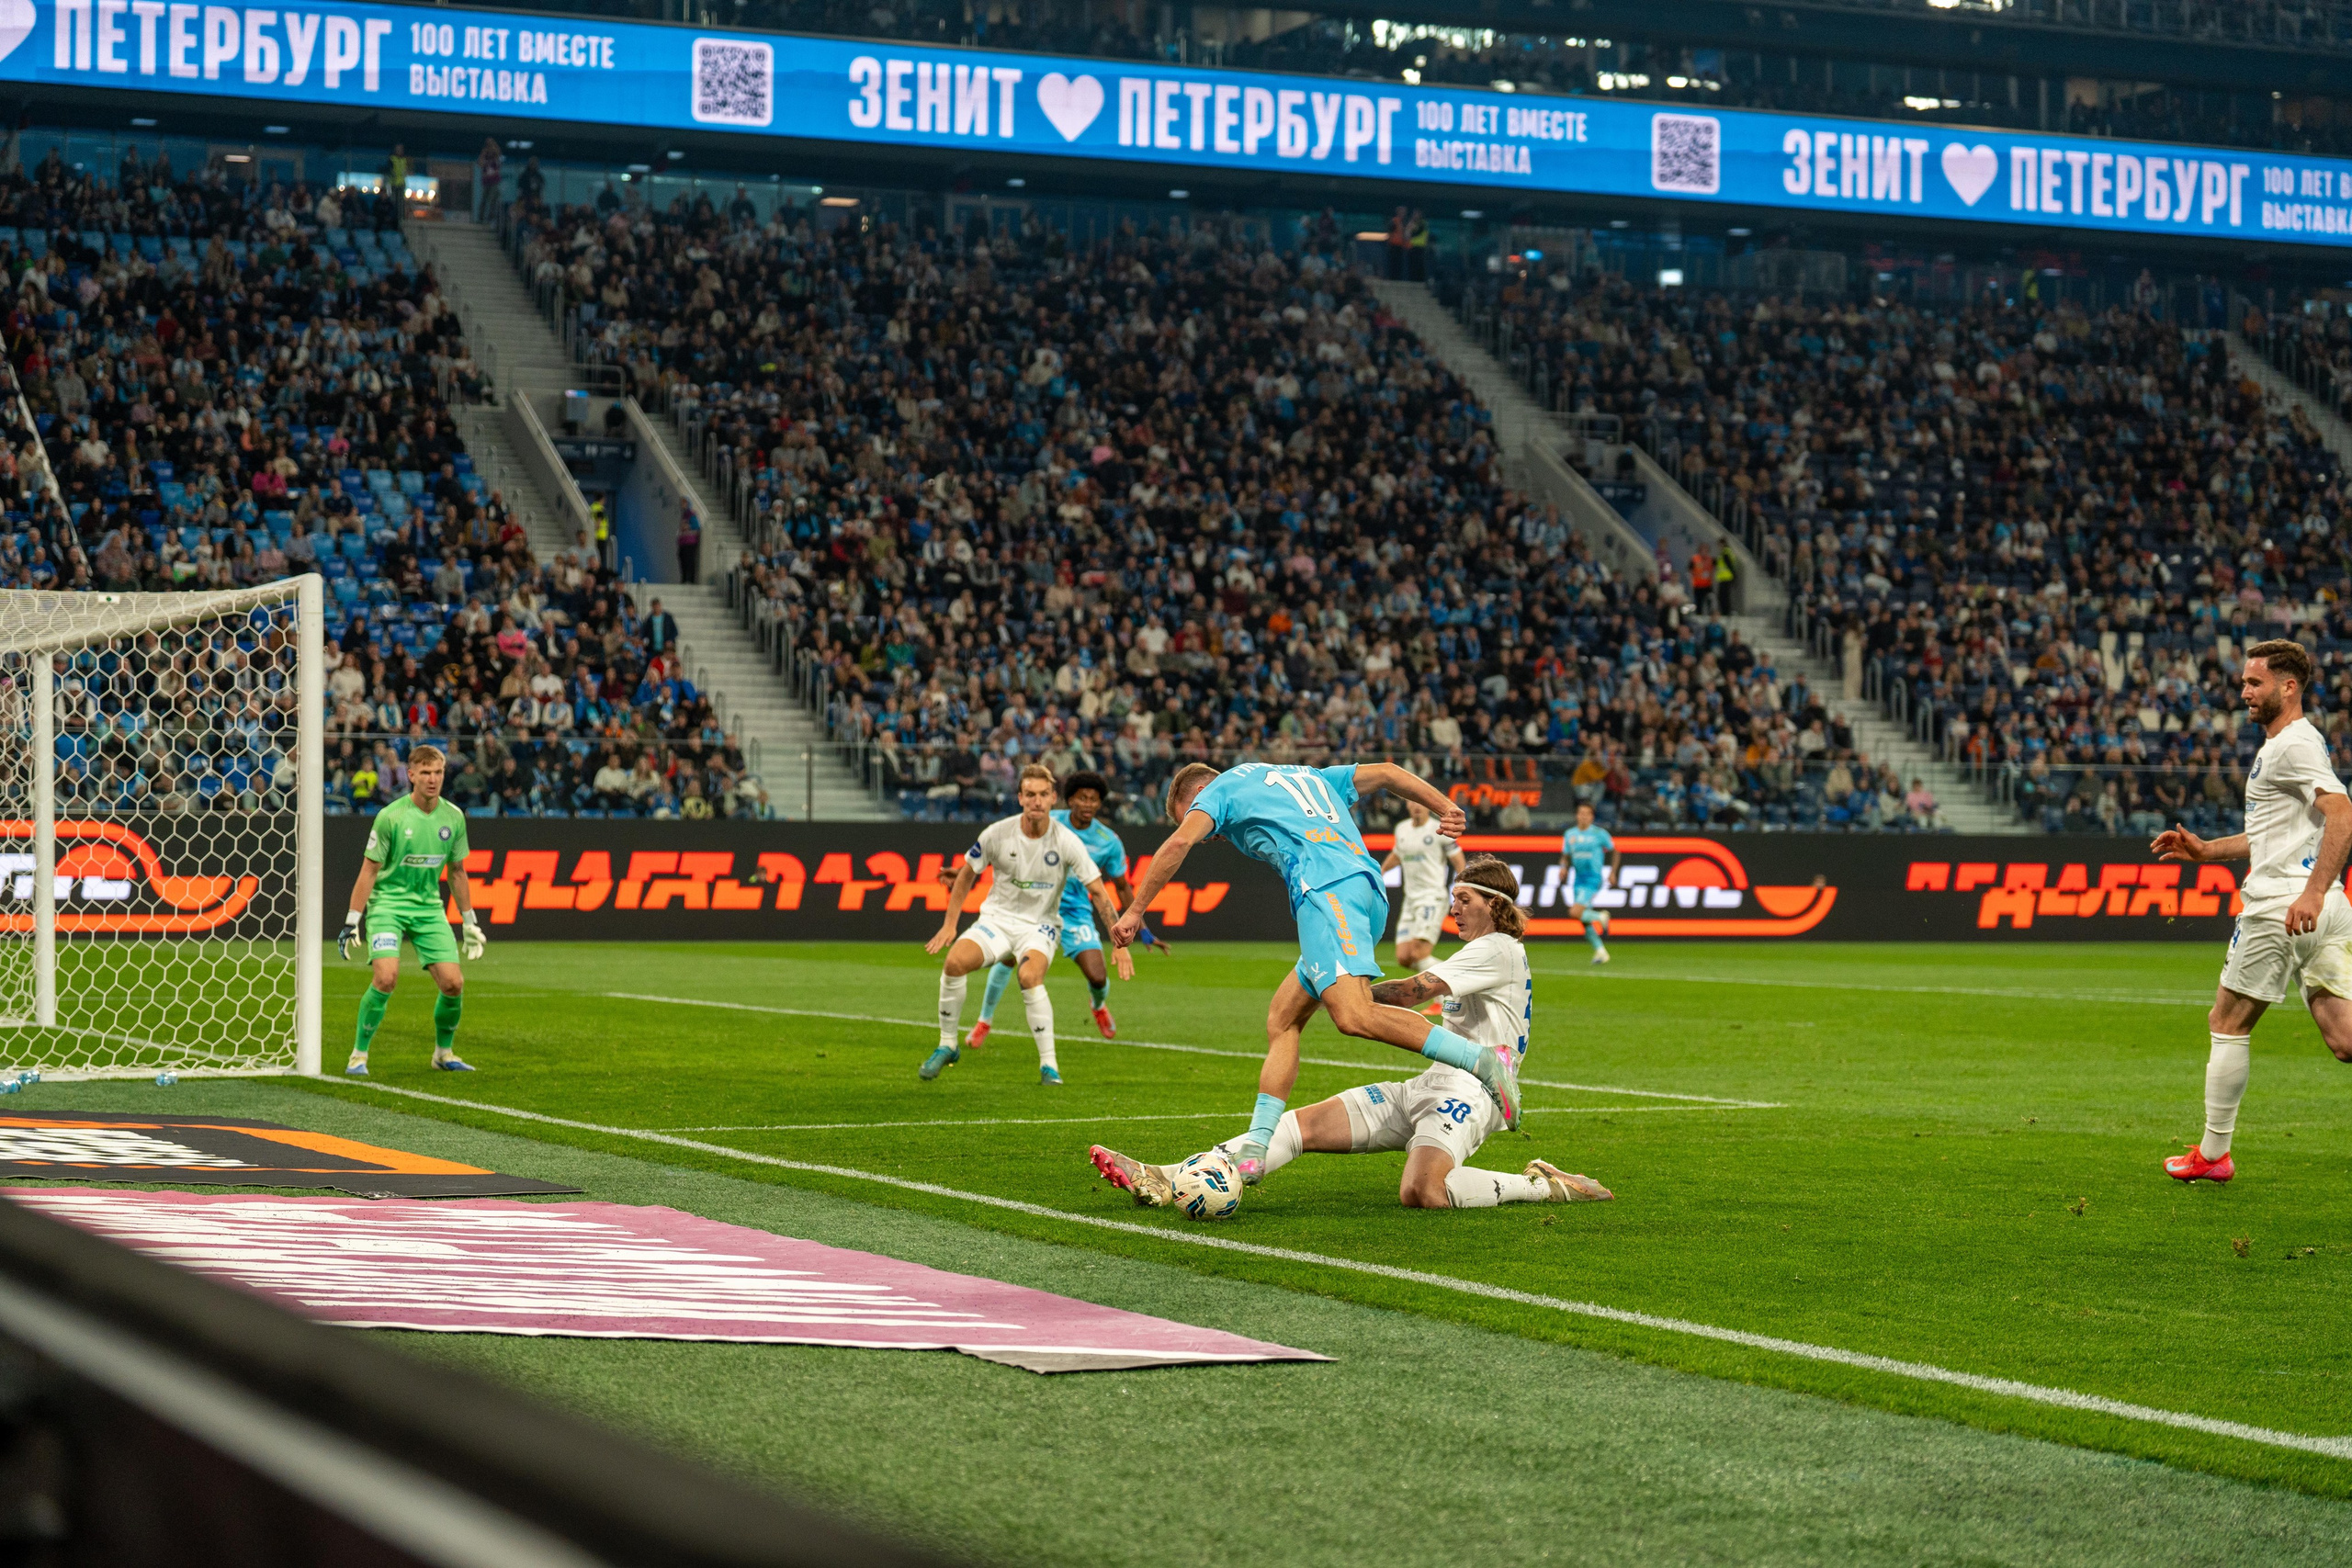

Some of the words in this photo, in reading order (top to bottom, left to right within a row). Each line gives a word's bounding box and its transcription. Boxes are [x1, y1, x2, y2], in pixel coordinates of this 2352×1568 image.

[54, 0, 392, 92] ПЕТЕРБУРГ
[411, 22, 454, 57] 100
[463, 27, 511, 61] ЛЕТ
[518, 30, 615, 69] ВМЕСТЕ
[410, 64, 548, 104] ВЫСТАВКА
[848, 56, 1023, 139] ЗЕНИТ
[1118, 77, 1402, 164] ПЕТЕРБУРГ
[1416, 100, 1453, 132] 100
[1460, 104, 1499, 135] ЛЕТ
[1507, 107, 1588, 142] ВМЕСТЕ
[1415, 138, 1532, 175] ВЫСТАВКА
[1782, 129, 1929, 203] ЗЕНИТ
[2010, 146, 2250, 227] ПЕТЕРБУРГ
[2263, 166, 2294, 196] 100
[2301, 169, 2333, 197] ЛЕТ
[2340, 172, 2352, 199] В
[2262, 201, 2352, 233] ВЫСТАВК
[1263, 770, 1340, 824] 10
[1436, 1097, 1471, 1124] 38
